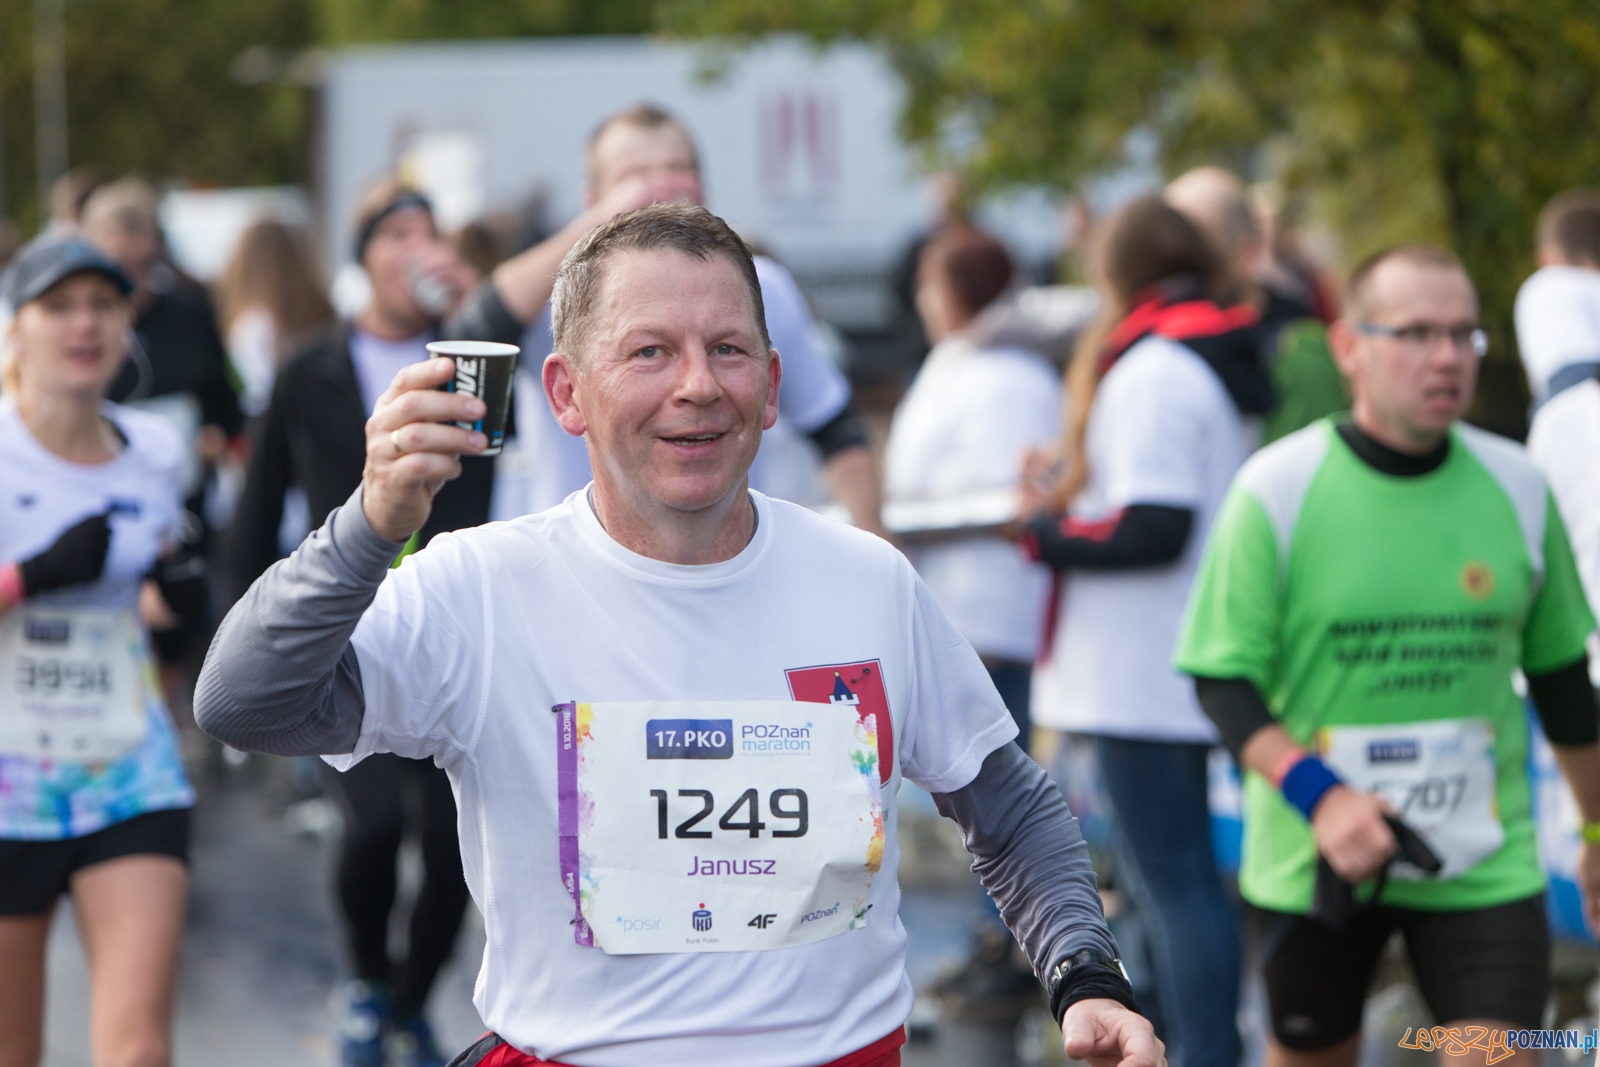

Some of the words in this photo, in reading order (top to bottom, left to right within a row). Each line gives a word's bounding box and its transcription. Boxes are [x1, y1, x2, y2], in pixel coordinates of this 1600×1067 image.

[742, 738, 811, 751] maraton
[650, 788, 809, 839] 1249
[687, 855, 777, 876] Janusz
[623, 917, 661, 933] posir
[747, 914, 778, 929] 4F
